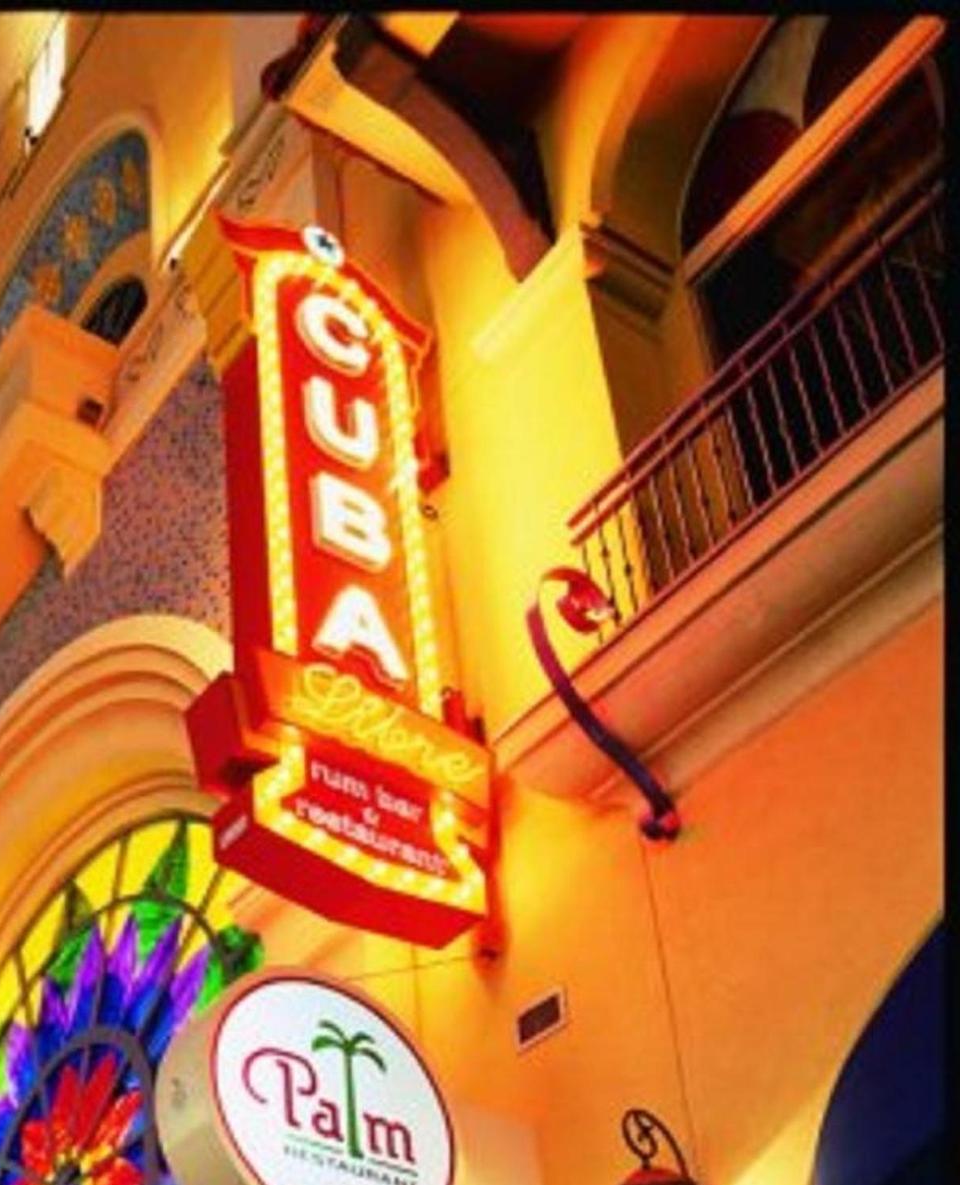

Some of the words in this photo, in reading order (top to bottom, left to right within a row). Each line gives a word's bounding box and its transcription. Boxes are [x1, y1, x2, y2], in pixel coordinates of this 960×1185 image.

[294, 292, 410, 690] CUBA
[289, 662, 485, 784] Libre
[294, 797, 449, 876] restaurant
[310, 760, 369, 800] rum
[374, 784, 424, 823] bar
[242, 1018, 417, 1165] Palm
